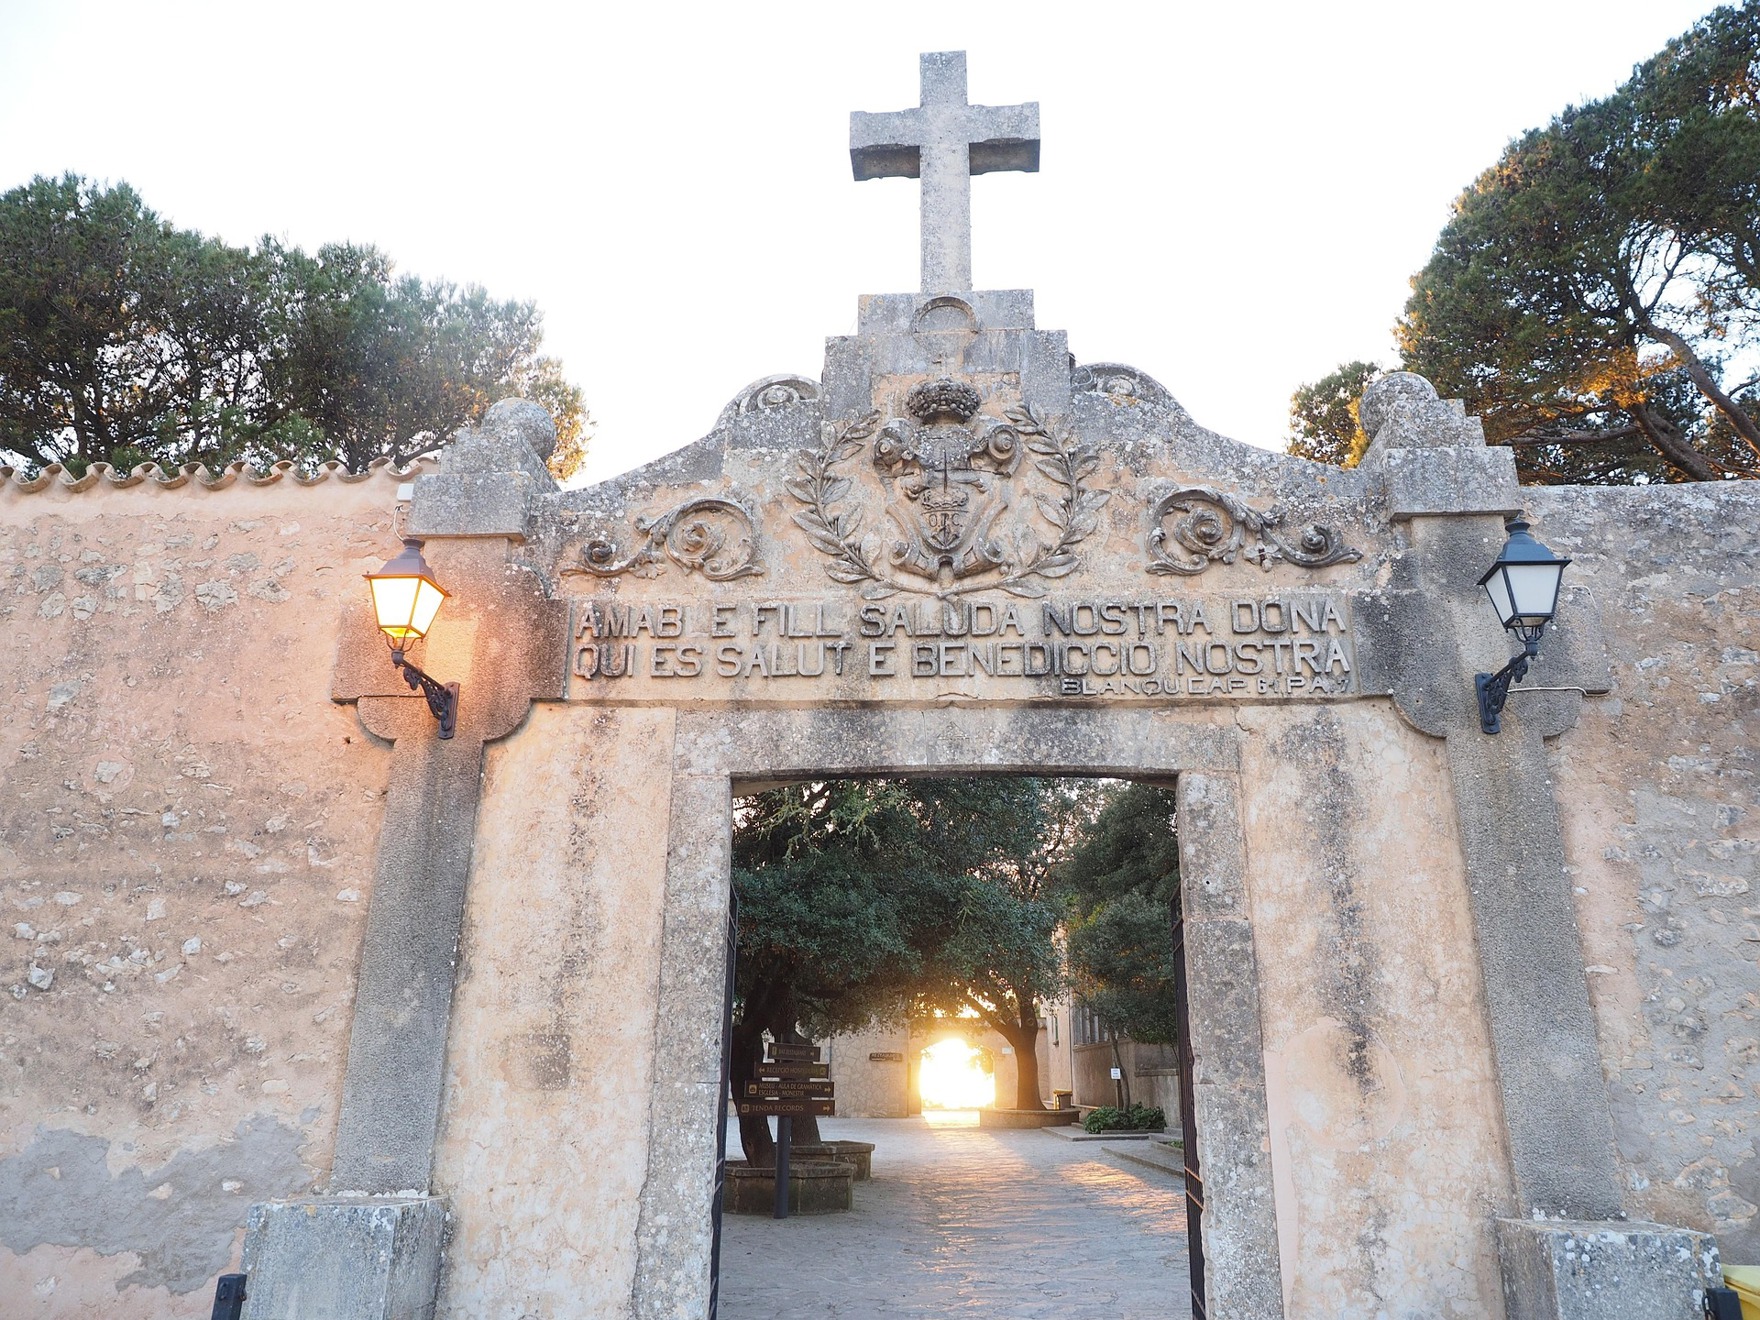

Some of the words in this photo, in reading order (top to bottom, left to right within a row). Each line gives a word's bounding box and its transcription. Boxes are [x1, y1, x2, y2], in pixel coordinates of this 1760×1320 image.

[575, 604, 736, 639] AMABLE
[752, 604, 841, 638] FILL
[859, 602, 1025, 638] SALUDA
[1042, 601, 1213, 636] NOSTRA
[1231, 600, 1347, 634] DONA
[573, 643, 637, 680] QUI
[651, 644, 703, 677] ES
[716, 641, 852, 678] SALUT
[868, 642, 895, 677] E
[1175, 638, 1351, 676] NOSTRA
[752, 1104, 773, 1112] TENDA
[774, 1104, 804, 1112] RECORDS
